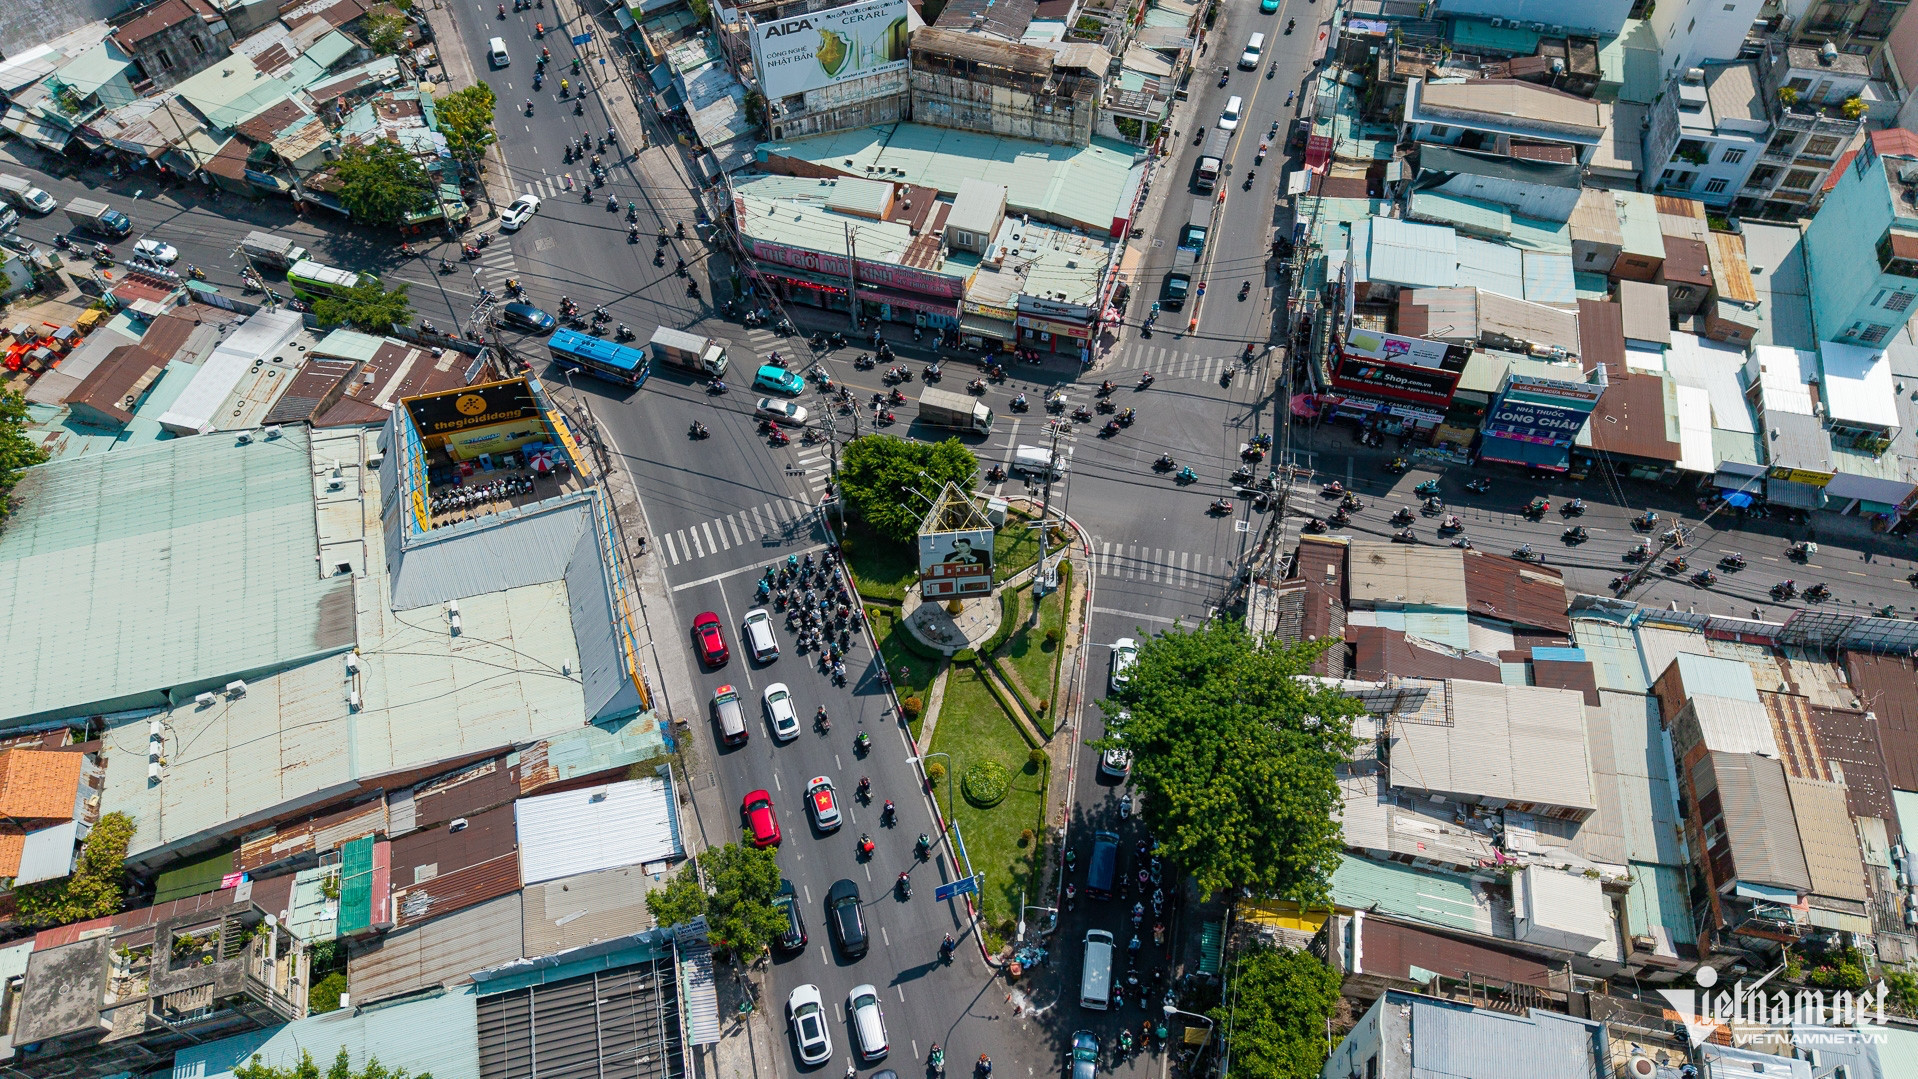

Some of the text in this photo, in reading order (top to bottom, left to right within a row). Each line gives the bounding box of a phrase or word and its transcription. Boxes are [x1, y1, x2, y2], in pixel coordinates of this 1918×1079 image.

[841, 10, 888, 25] CERARL
[764, 19, 813, 39] AICA
[766, 45, 808, 59] CÔNG NGHỆ
[767, 51, 814, 68] NHẬT BẢN
[760, 246, 787, 263] THẾ
[791, 251, 821, 271] GIỚI
[859, 265, 893, 283] KÍNH
[1357, 367, 1384, 378] FPT
[433, 408, 522, 430] thegioididong
[1494, 411, 1580, 431] LONG CHÂU
[1536, 408, 1566, 418] THUỐC
